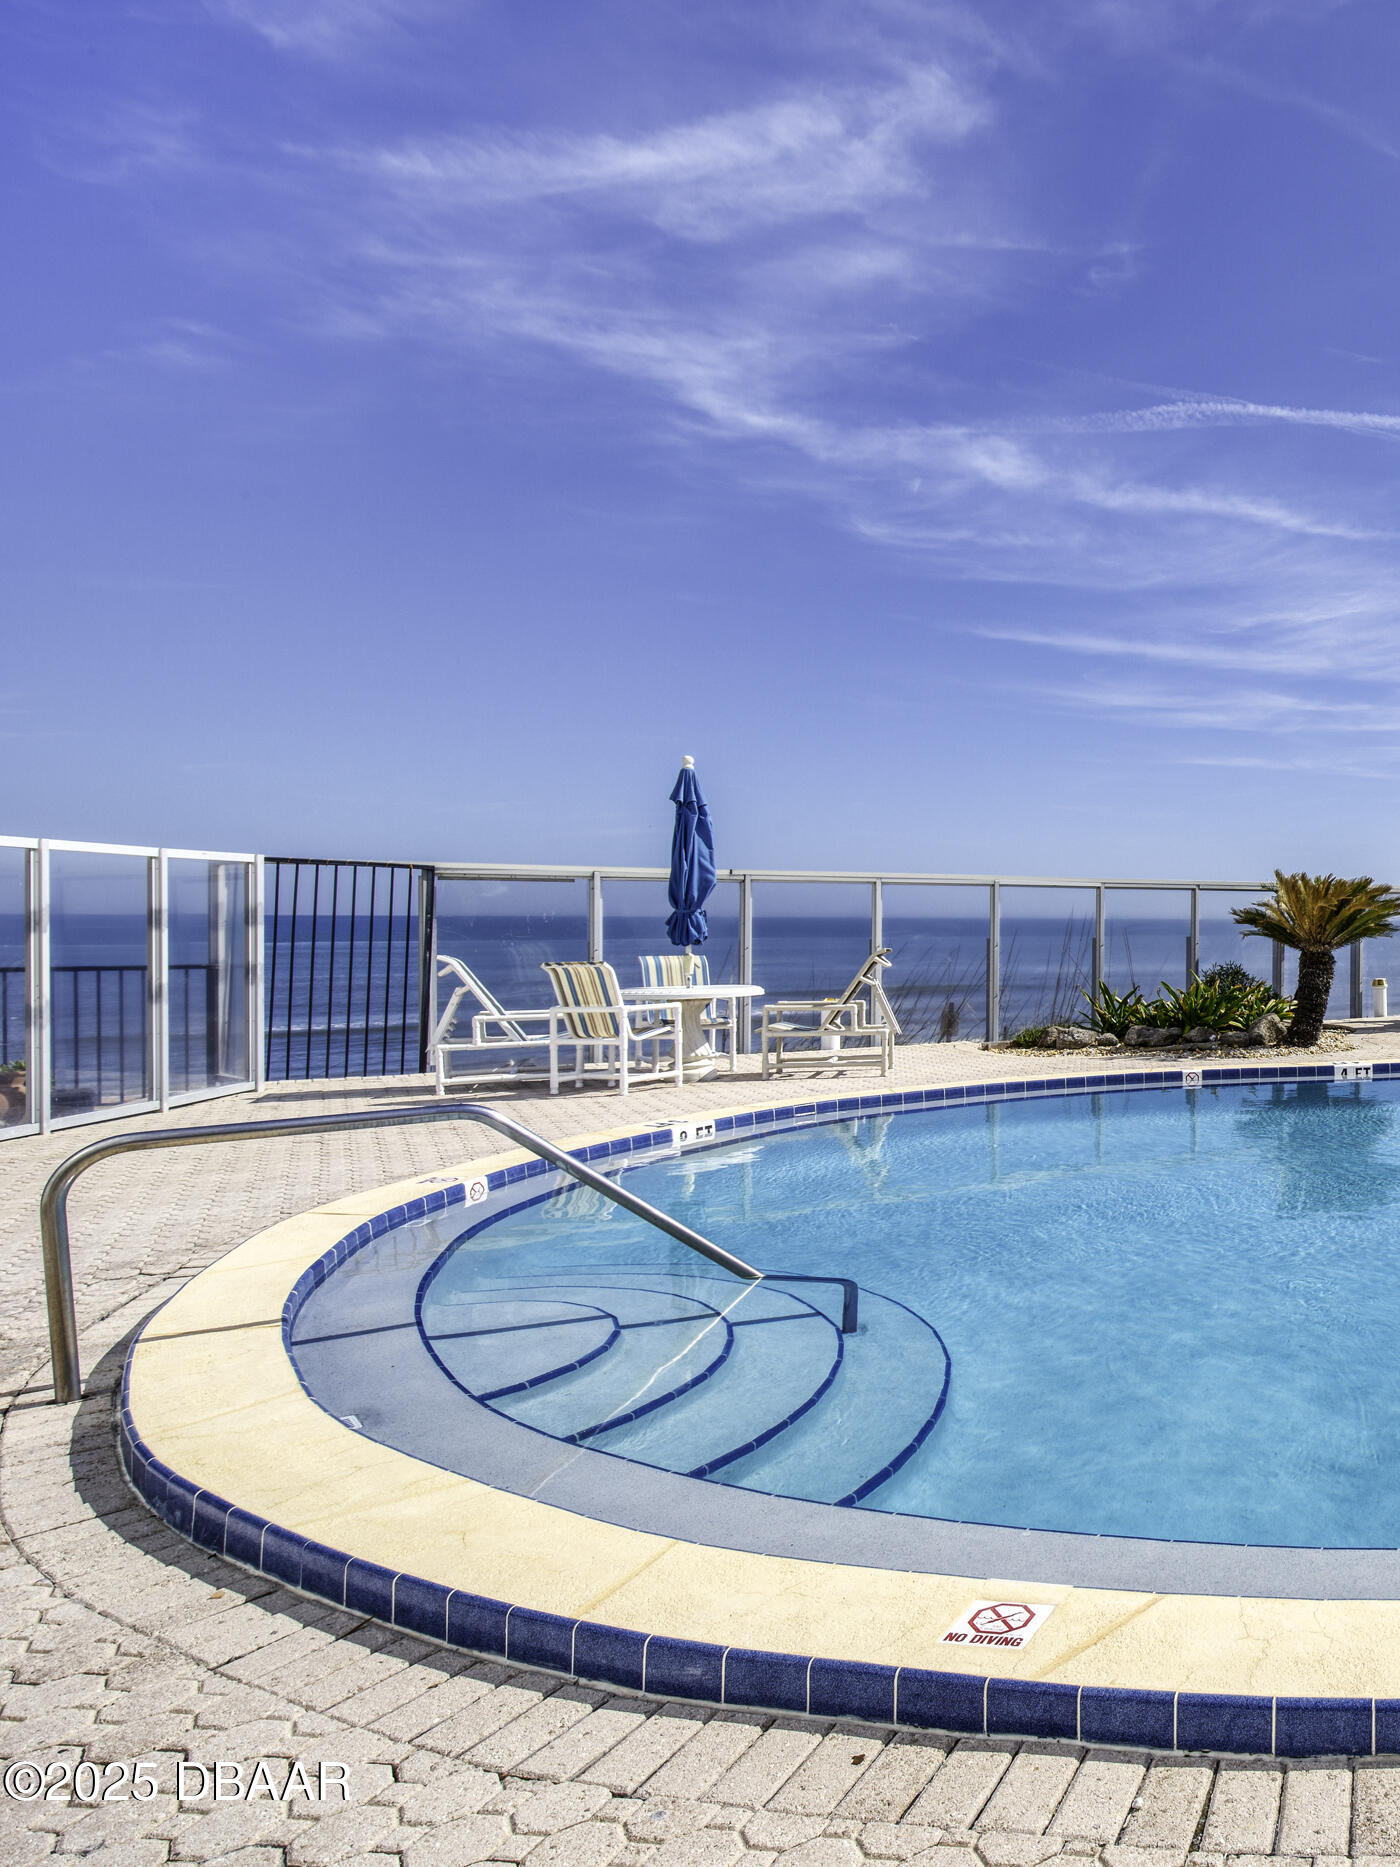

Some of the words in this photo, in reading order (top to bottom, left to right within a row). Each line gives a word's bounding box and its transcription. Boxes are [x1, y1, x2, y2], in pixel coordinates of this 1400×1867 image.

[1355, 1066, 1371, 1076] FT
[943, 1631, 968, 1643] NO
[969, 1634, 1024, 1647] DIVING
